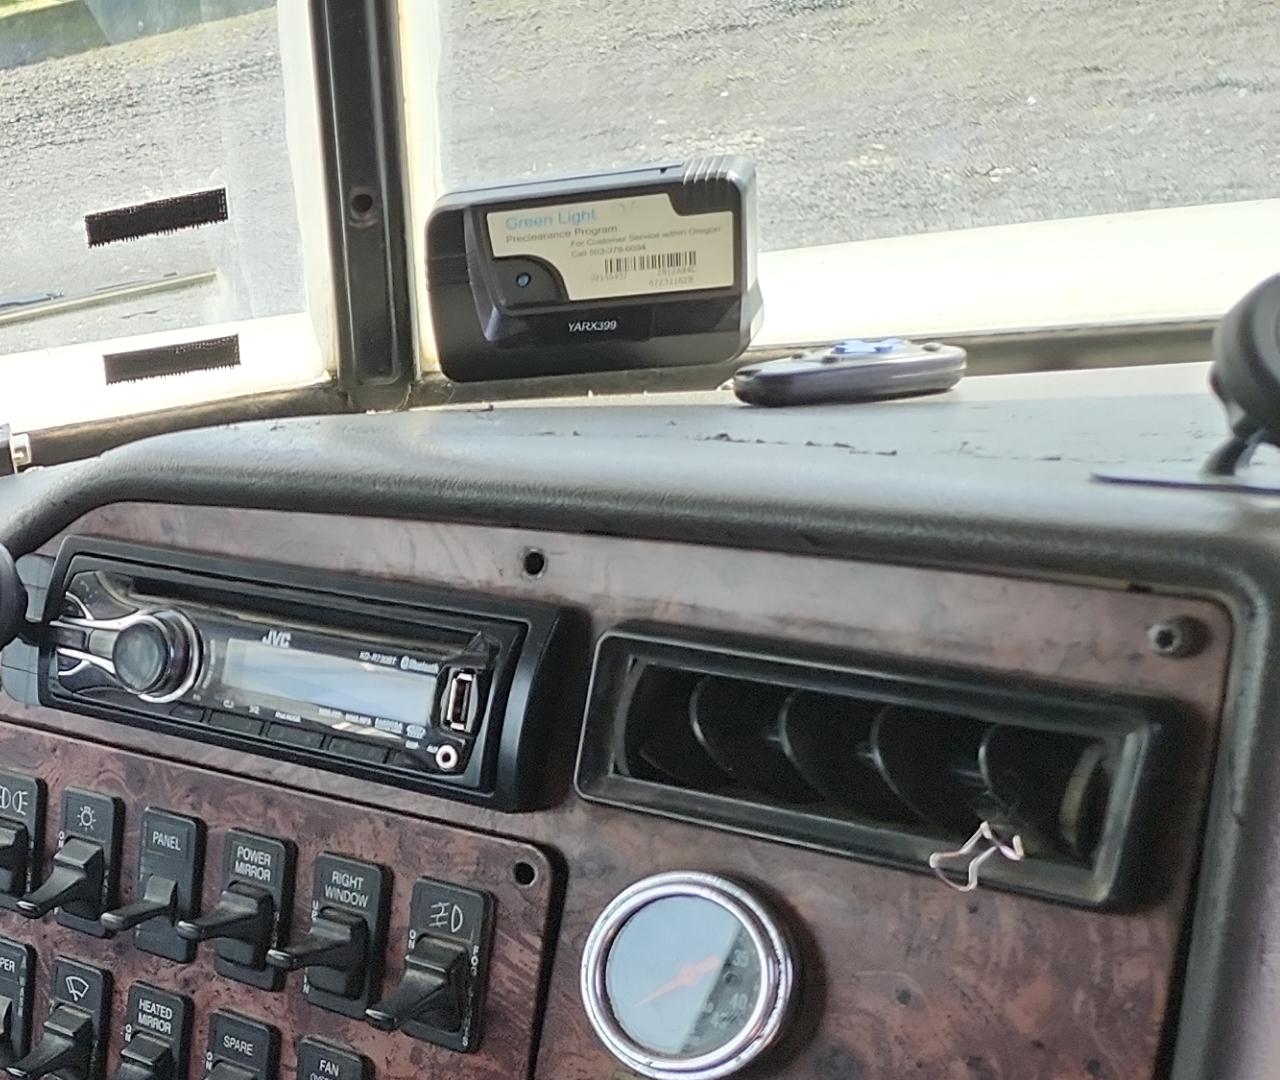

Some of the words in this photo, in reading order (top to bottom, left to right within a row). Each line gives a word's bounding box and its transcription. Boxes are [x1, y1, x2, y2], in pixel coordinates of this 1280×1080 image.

[505, 213, 553, 231] Green
[558, 209, 598, 227] Light
[505, 229, 572, 243] Preclearance
[574, 225, 618, 239] Program
[586, 235, 627, 246] Customer
[567, 319, 617, 333] YARX399
[262, 630, 292, 648] JVC
[152, 831, 181, 851] PANEL
[237, 846, 272, 866] POWER
[234, 860, 271, 882] MIRROR
[331, 870, 364, 890] RIGHT
[325, 884, 369, 908] WINDOW
[138, 998, 173, 1019] HEATED
[137, 1013, 172, 1034] MIRROR
[223, 1035, 254, 1056] SPARE
[319, 1059, 340, 1077] FAN
